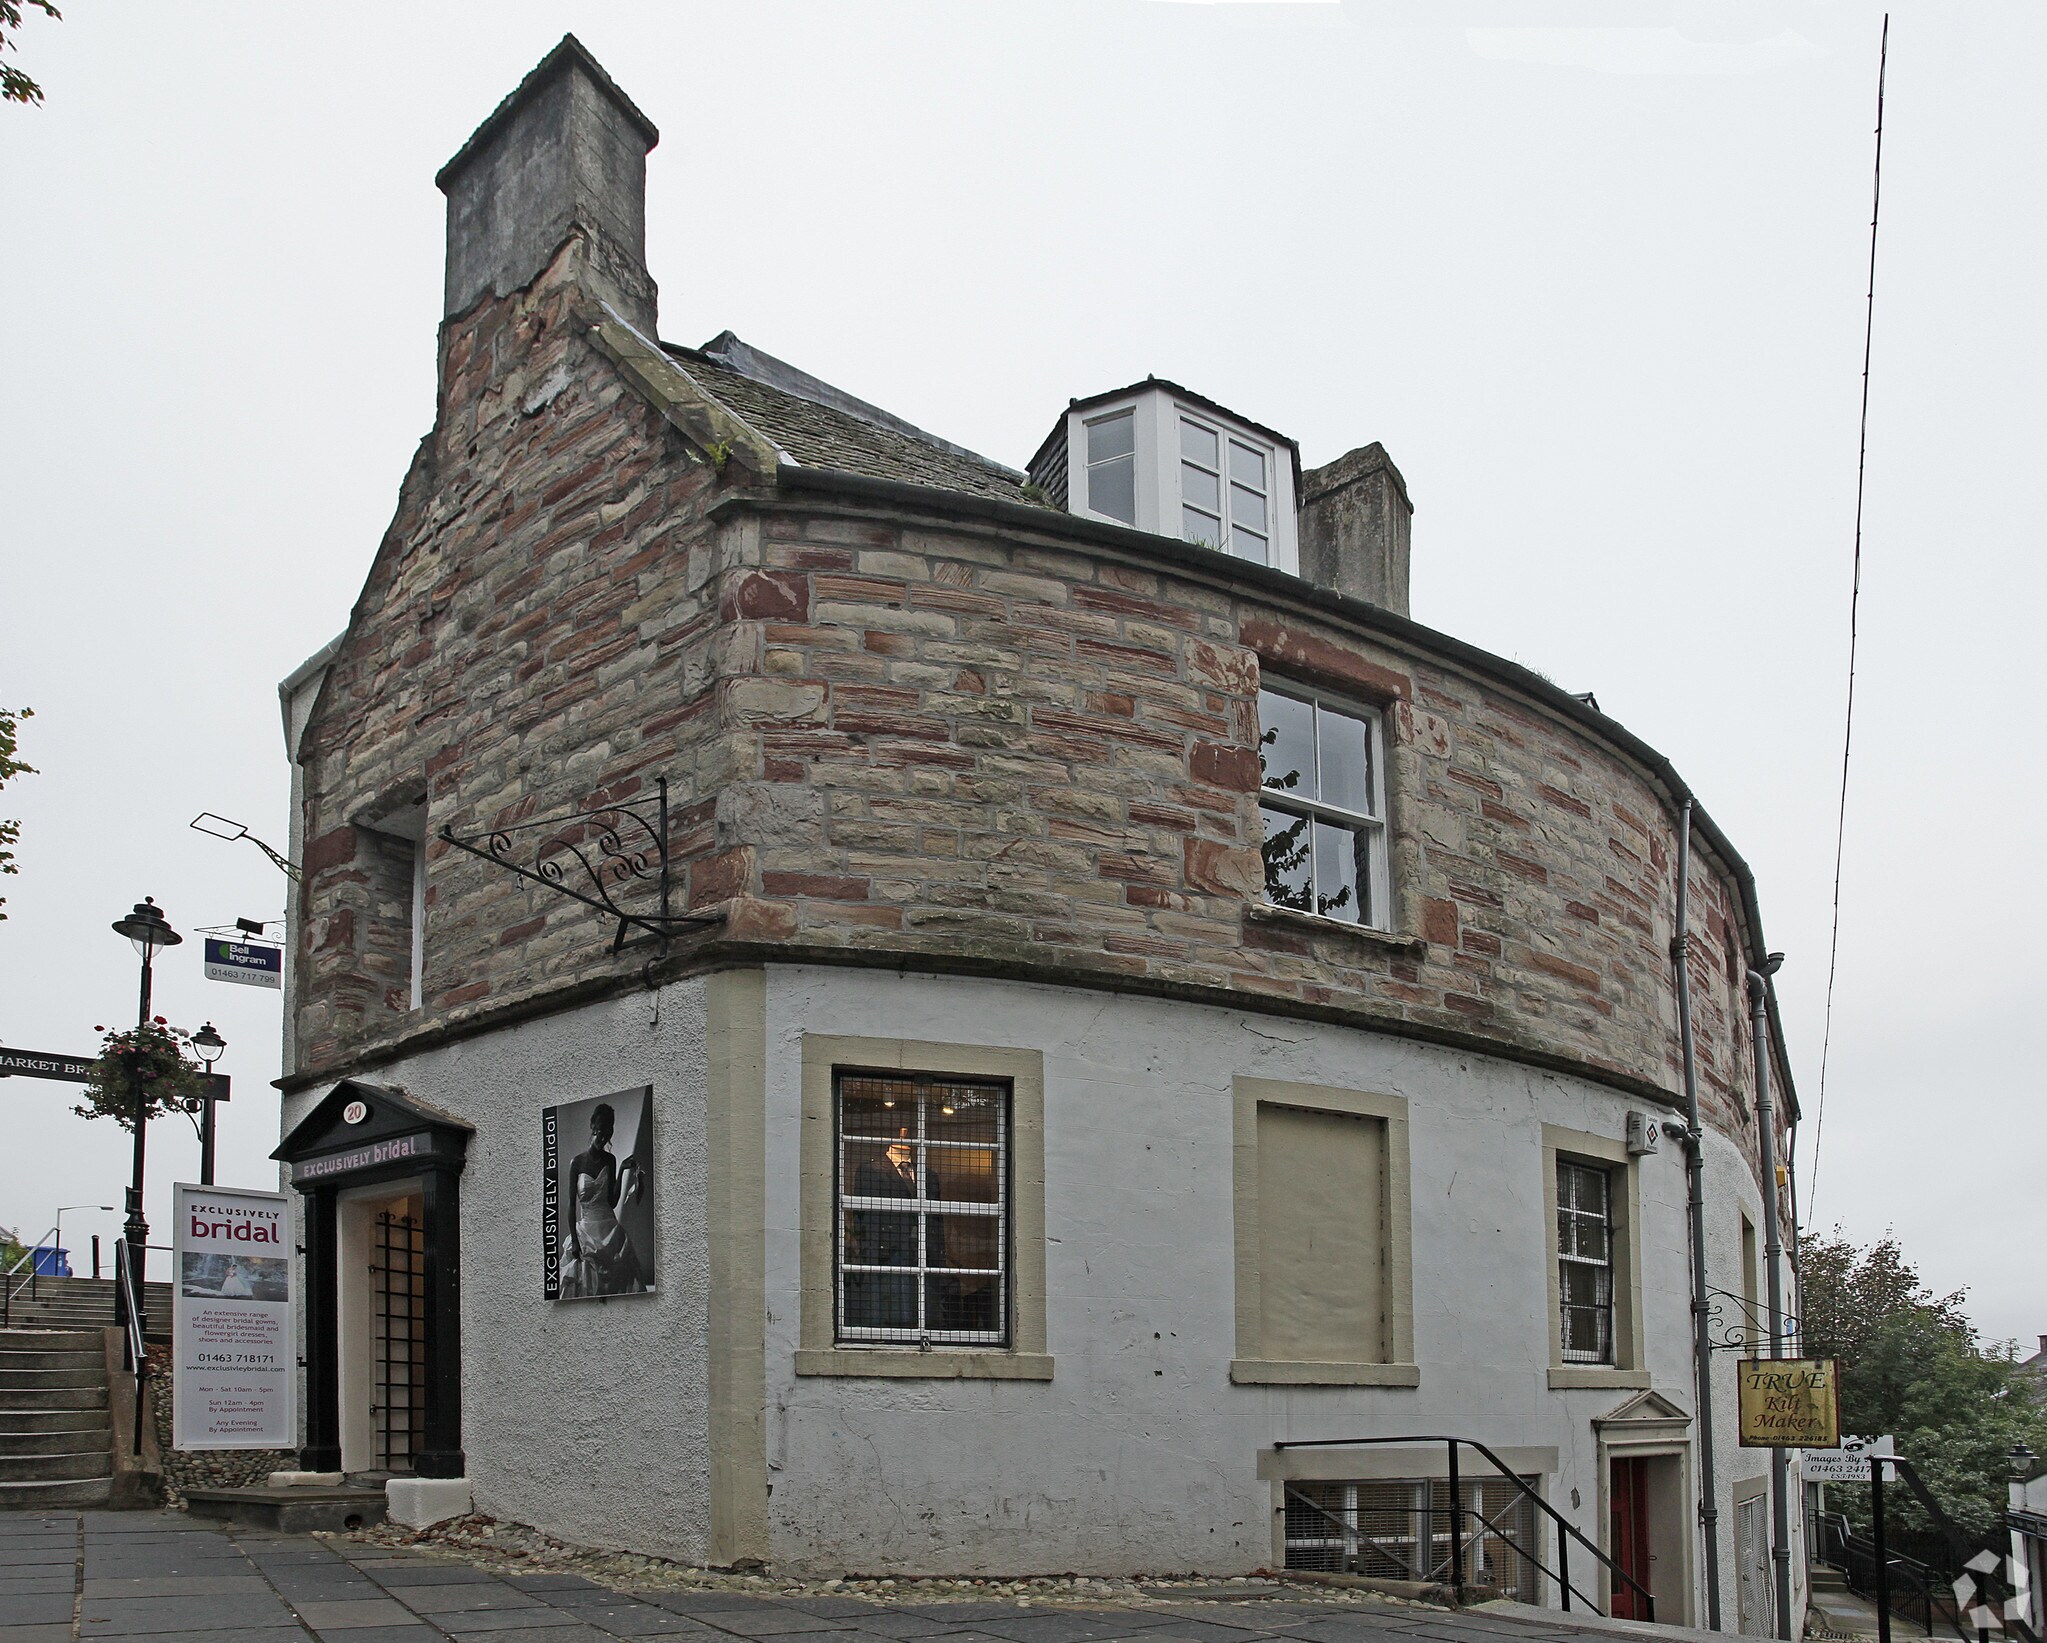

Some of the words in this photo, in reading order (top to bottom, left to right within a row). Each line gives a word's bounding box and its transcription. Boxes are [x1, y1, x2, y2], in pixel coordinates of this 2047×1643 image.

[230, 944, 249, 954] Bell
[230, 953, 266, 965] Ingram
[212, 968, 238, 978] 01463
[260, 975, 275, 983] 799
[348, 1105, 362, 1120] 20
[545, 1115, 556, 1170] bridal
[303, 1151, 370, 1178] EXCLUSIVELY
[374, 1137, 416, 1163] bridal
[191, 1205, 279, 1219] EXCLUSIVELY
[192, 1216, 279, 1243] bridal
[546, 1177, 557, 1292] EXCLUSIVELY
[198, 1353, 232, 1362] 01463
[236, 1355, 274, 1363] 718171
[1747, 1371, 1825, 1393] TRUE
[1765, 1394, 1801, 1413] Kilt
[1754, 1413, 1817, 1431] Maker
[1805, 1454, 1841, 1464] Images
[1845, 1454, 1861, 1464] By
